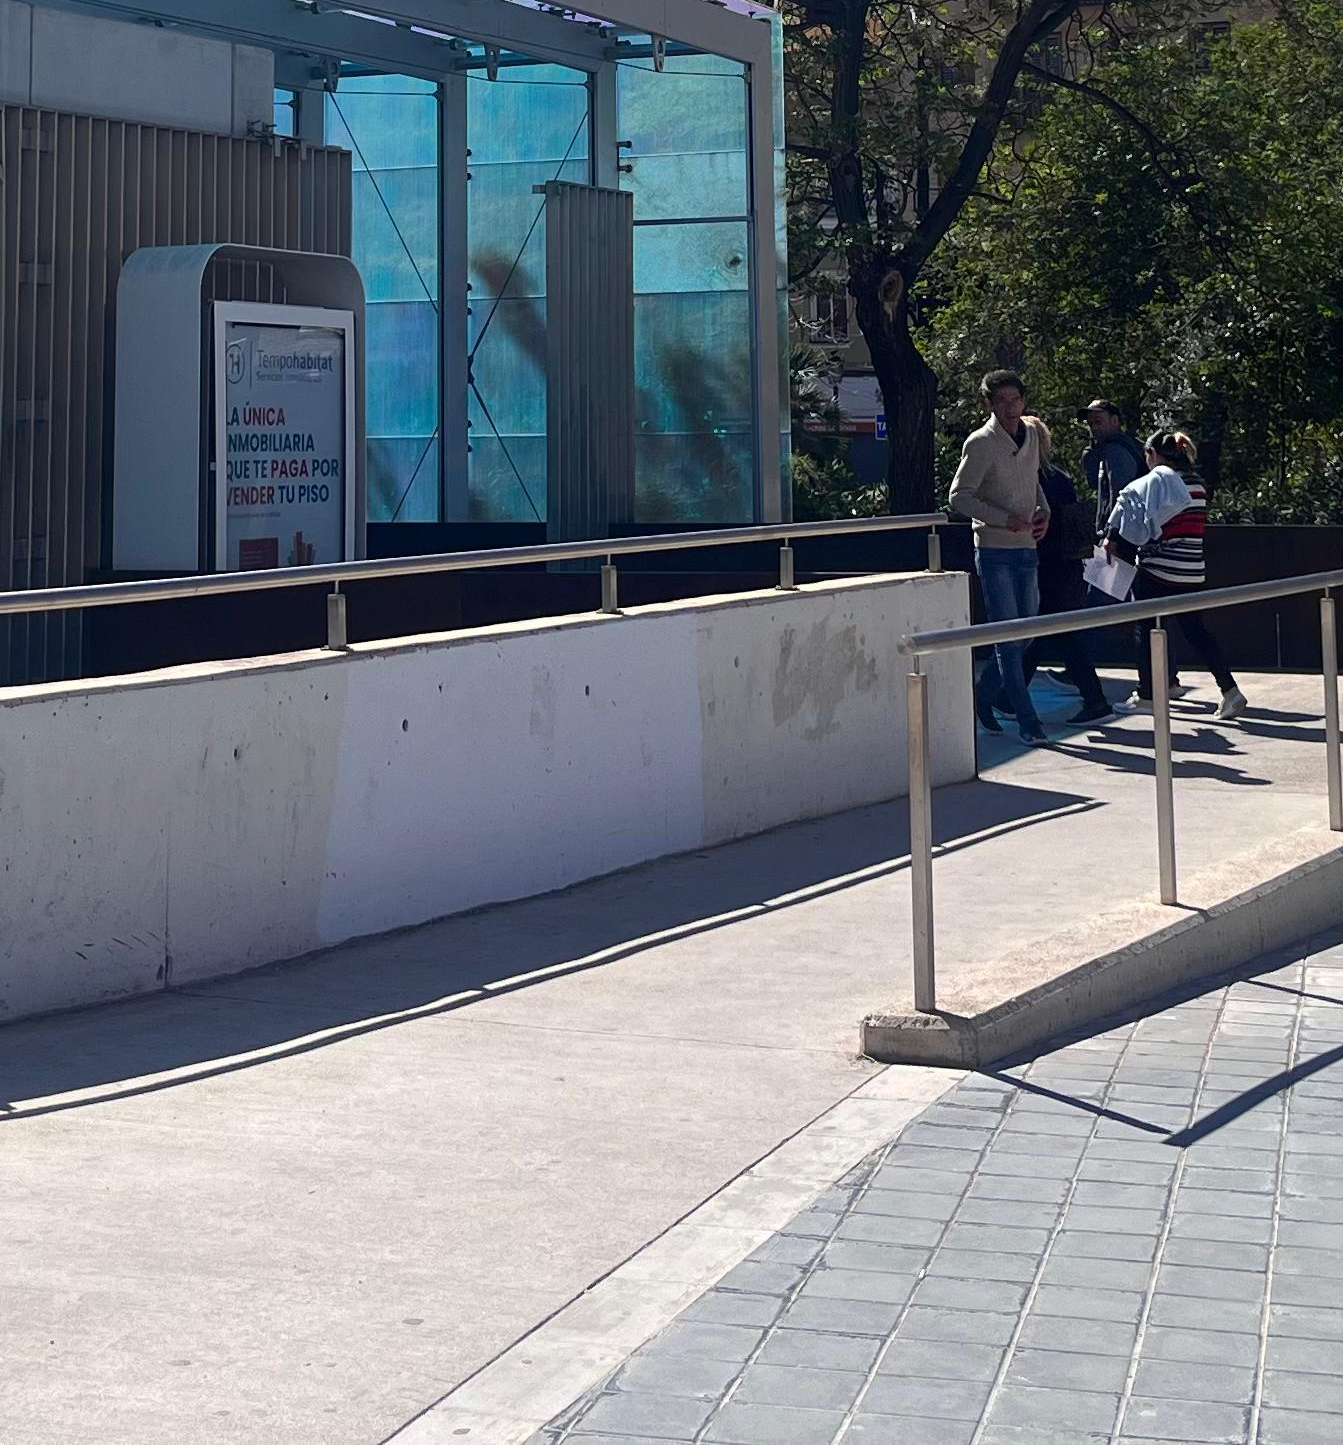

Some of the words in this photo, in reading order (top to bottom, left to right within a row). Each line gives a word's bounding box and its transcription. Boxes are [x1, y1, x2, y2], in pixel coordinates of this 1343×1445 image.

[256, 349, 334, 373] Tempohabitat
[243, 402, 286, 426] ÚNICA
[227, 433, 315, 452] NMOBILIARIA
[226, 460, 250, 482] QUE
[253, 460, 267, 478] TE
[271, 459, 309, 478] PAGA
[311, 458, 339, 477] POR
[226, 485, 275, 506] VENDER
[278, 485, 295, 504] TU
[299, 484, 330, 504] PISO
